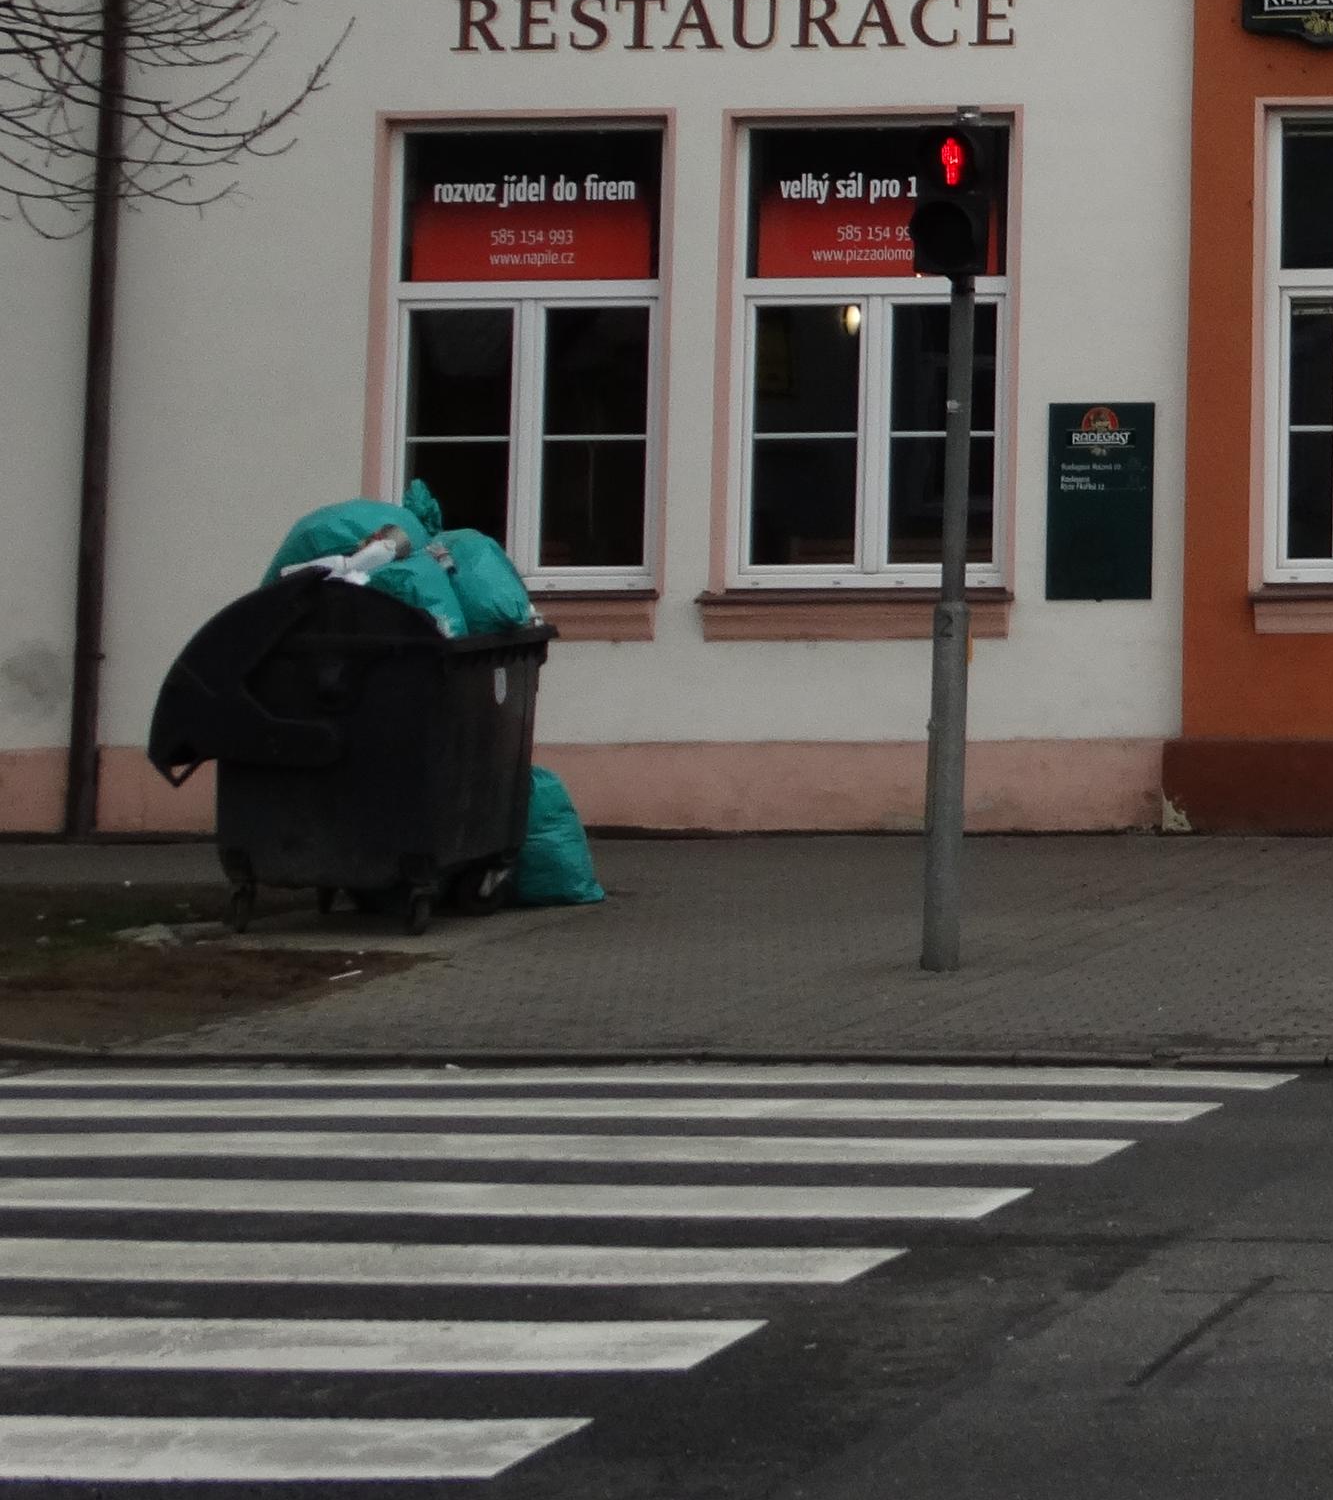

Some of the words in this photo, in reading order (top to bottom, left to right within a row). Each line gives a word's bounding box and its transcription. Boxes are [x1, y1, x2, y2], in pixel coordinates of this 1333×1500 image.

[434, 182, 496, 203] rozvoz
[499, 174, 546, 208] jídel
[553, 174, 577, 201] do
[584, 173, 636, 200] firem
[780, 172, 829, 204] velký
[836, 171, 863, 199] sál
[870, 179, 901, 204] pro
[490, 228, 516, 246] 585
[520, 230, 544, 245] 154
[549, 229, 574, 246] 993
[837, 225, 862, 242] 585
[867, 226, 890, 242] 154
[895, 226, 912, 242] 99
[489, 250, 575, 267] www.napile.cz
[812, 246, 914, 264] www.pizzaolomo
[1072, 432, 1131, 445] RADEGAST
